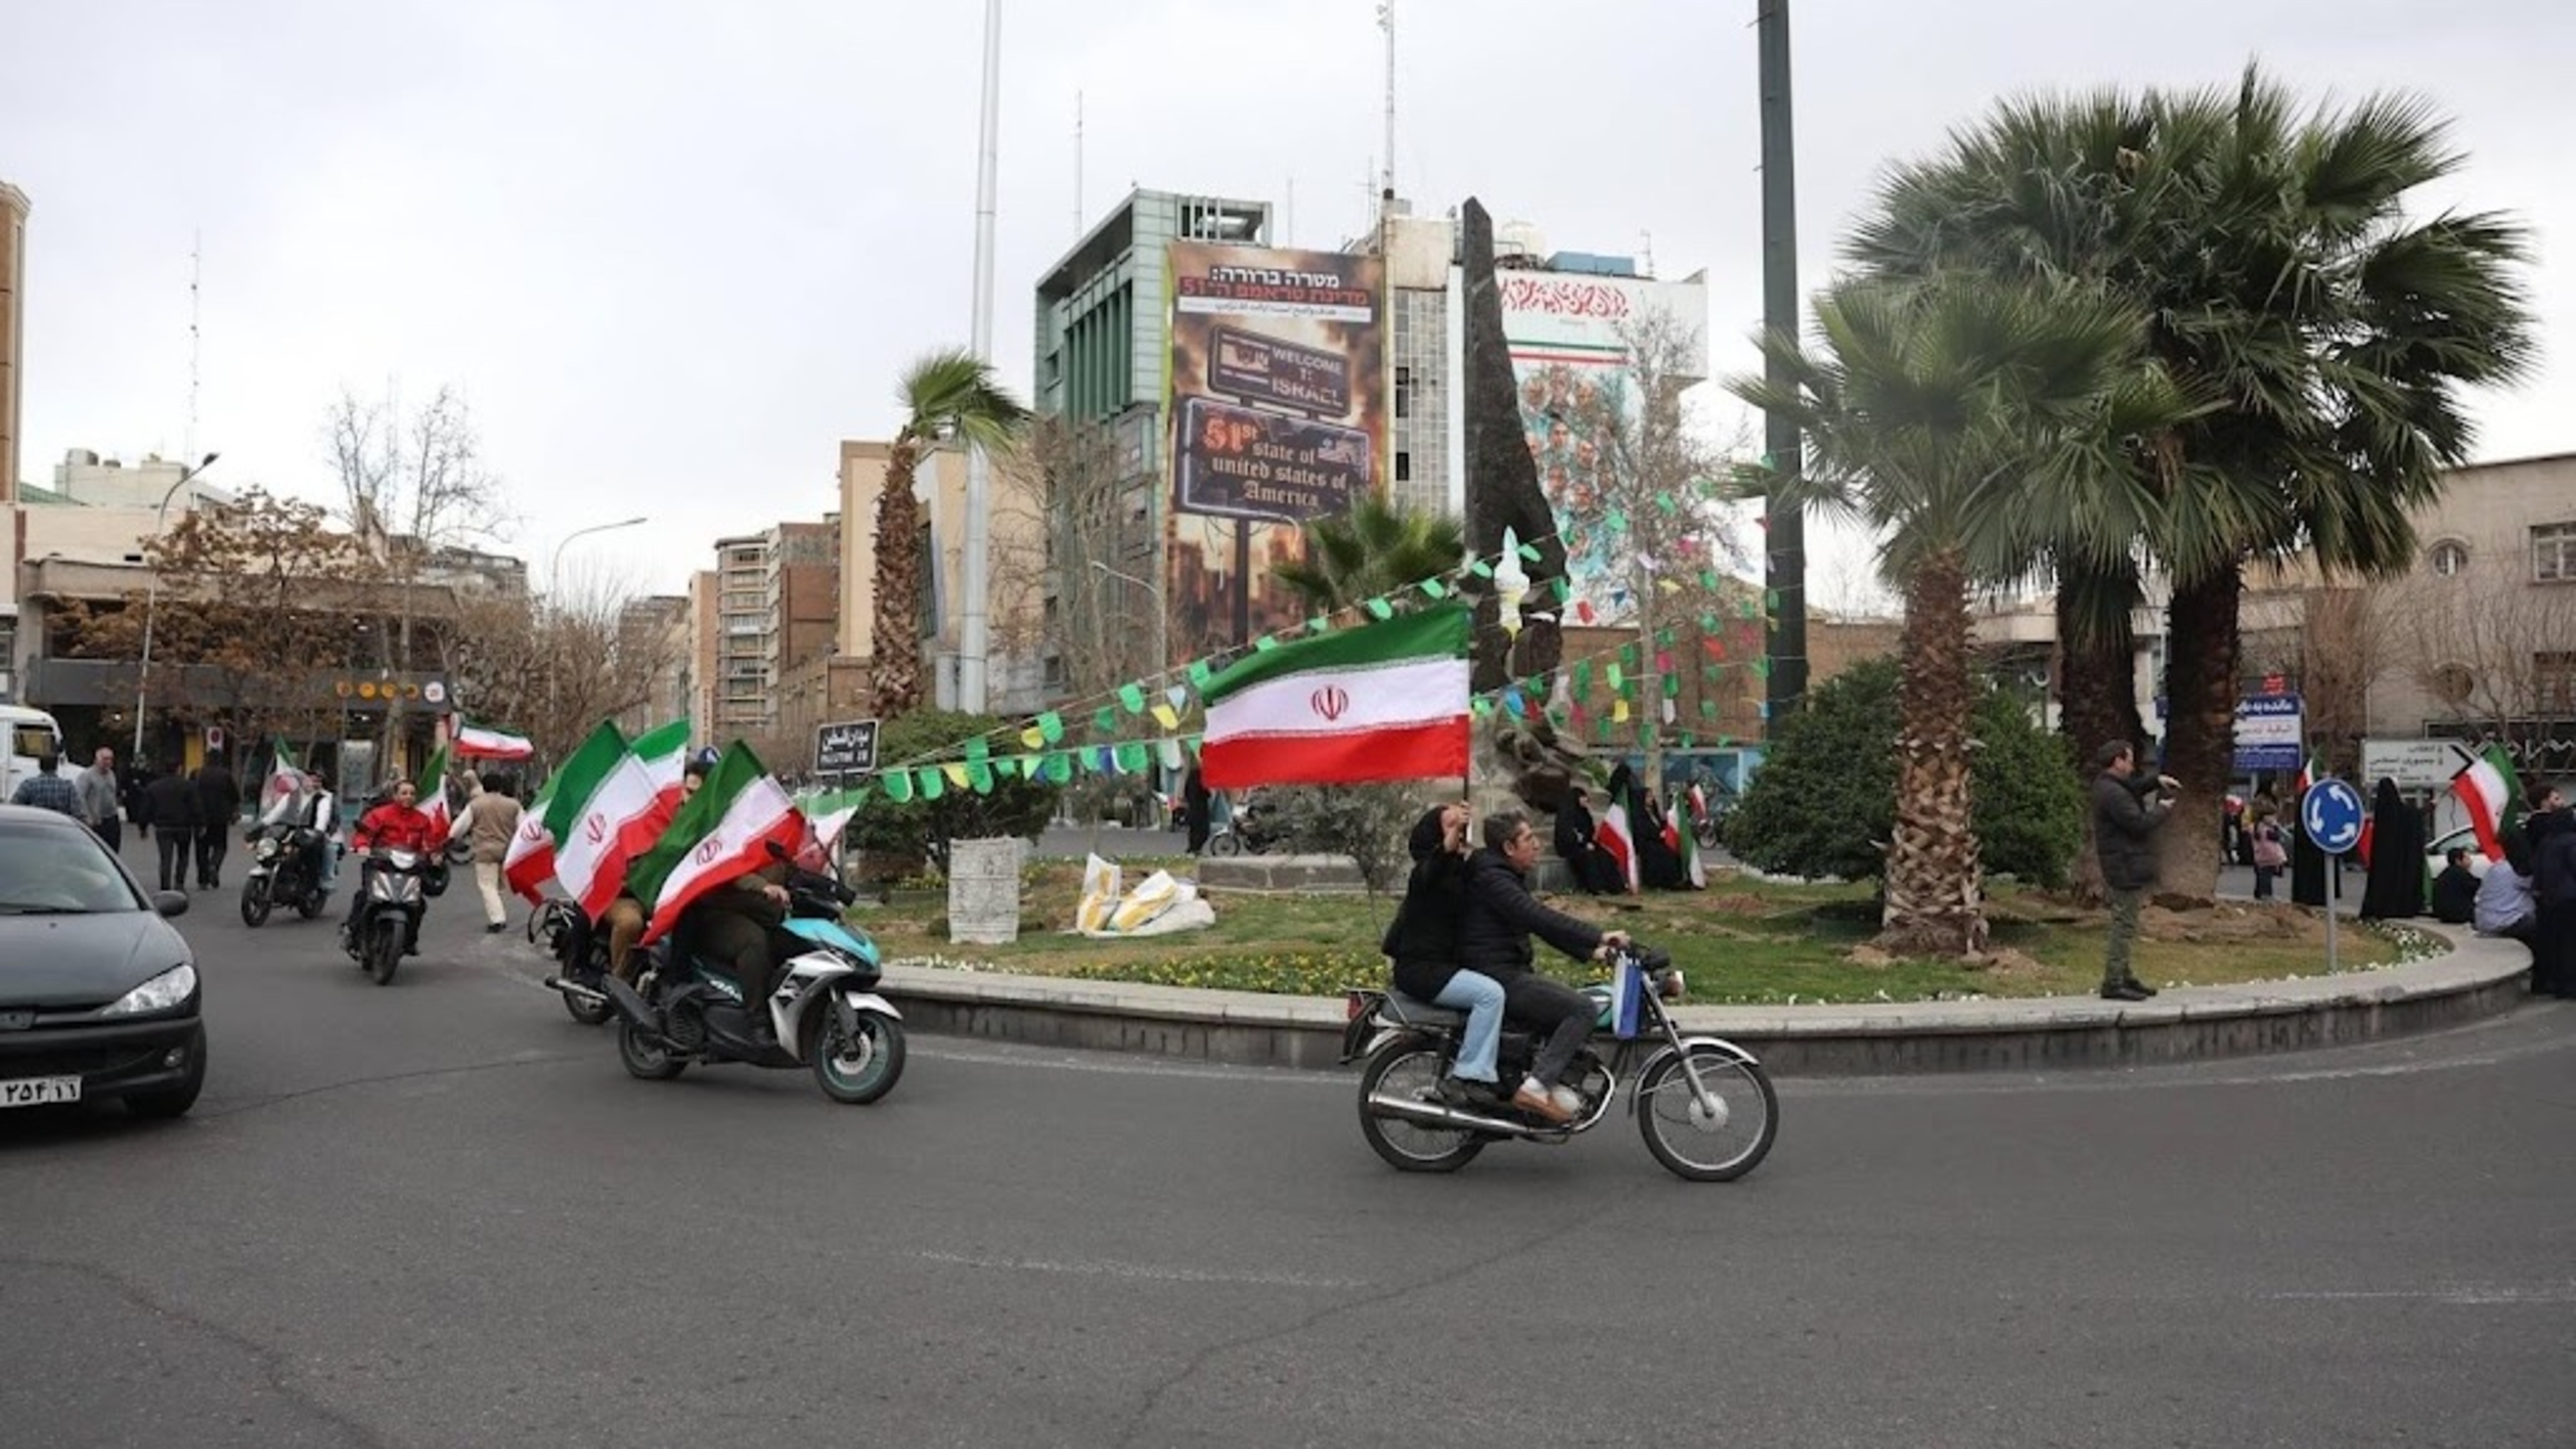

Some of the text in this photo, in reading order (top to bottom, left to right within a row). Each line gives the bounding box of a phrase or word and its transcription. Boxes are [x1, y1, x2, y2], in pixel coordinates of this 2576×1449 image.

[1285, 272, 1339, 288] מטרה
[1272, 345, 1342, 374] WELCOME
[1272, 377, 1344, 408] ISRAEL
[1252, 440, 1294, 462] state
[1300, 446, 1316, 464] of
[1211, 456, 1347, 490] united states of
[1244, 480, 1320, 506] America
